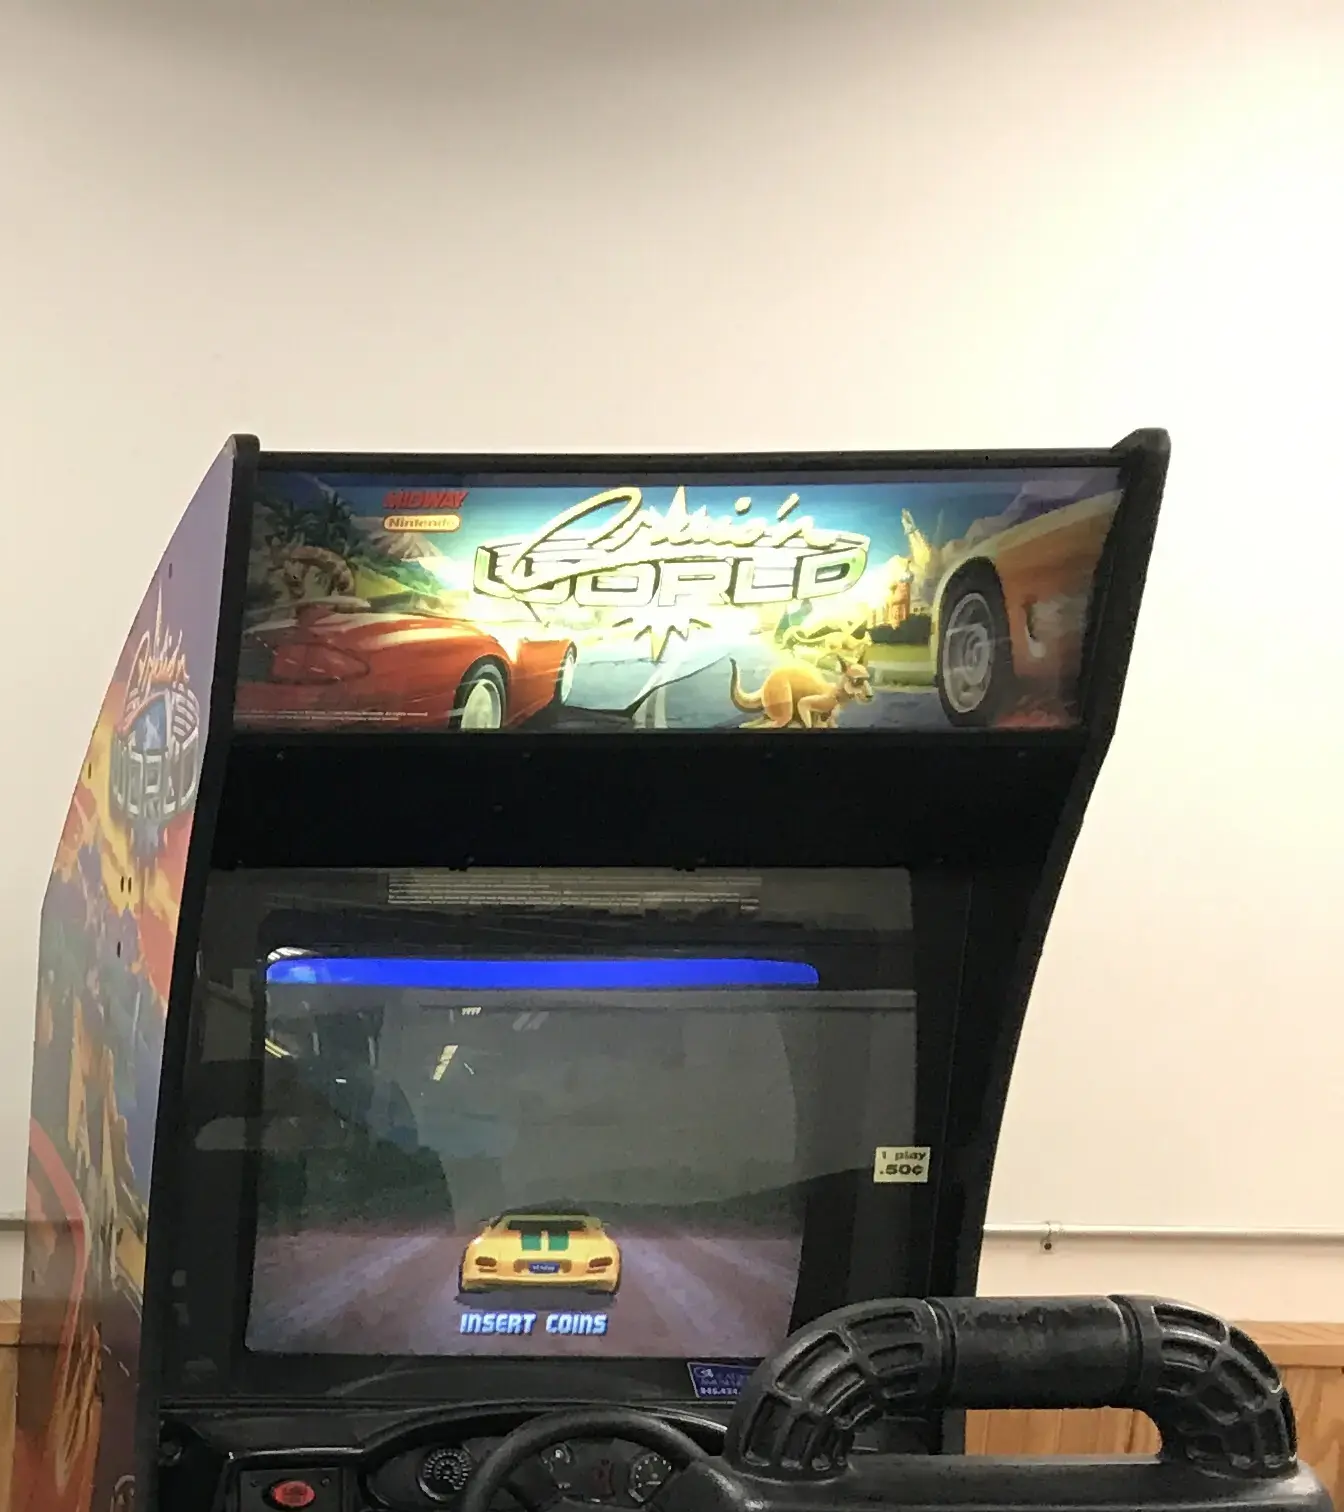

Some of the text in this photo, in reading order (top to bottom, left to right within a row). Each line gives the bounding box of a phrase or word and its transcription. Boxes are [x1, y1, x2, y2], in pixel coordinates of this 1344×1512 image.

[382, 491, 469, 509] MIDWAY
[388, 516, 455, 529] Nintendo
[895, 1150, 926, 1161] play
[459, 1312, 608, 1334] INSERT COINS
